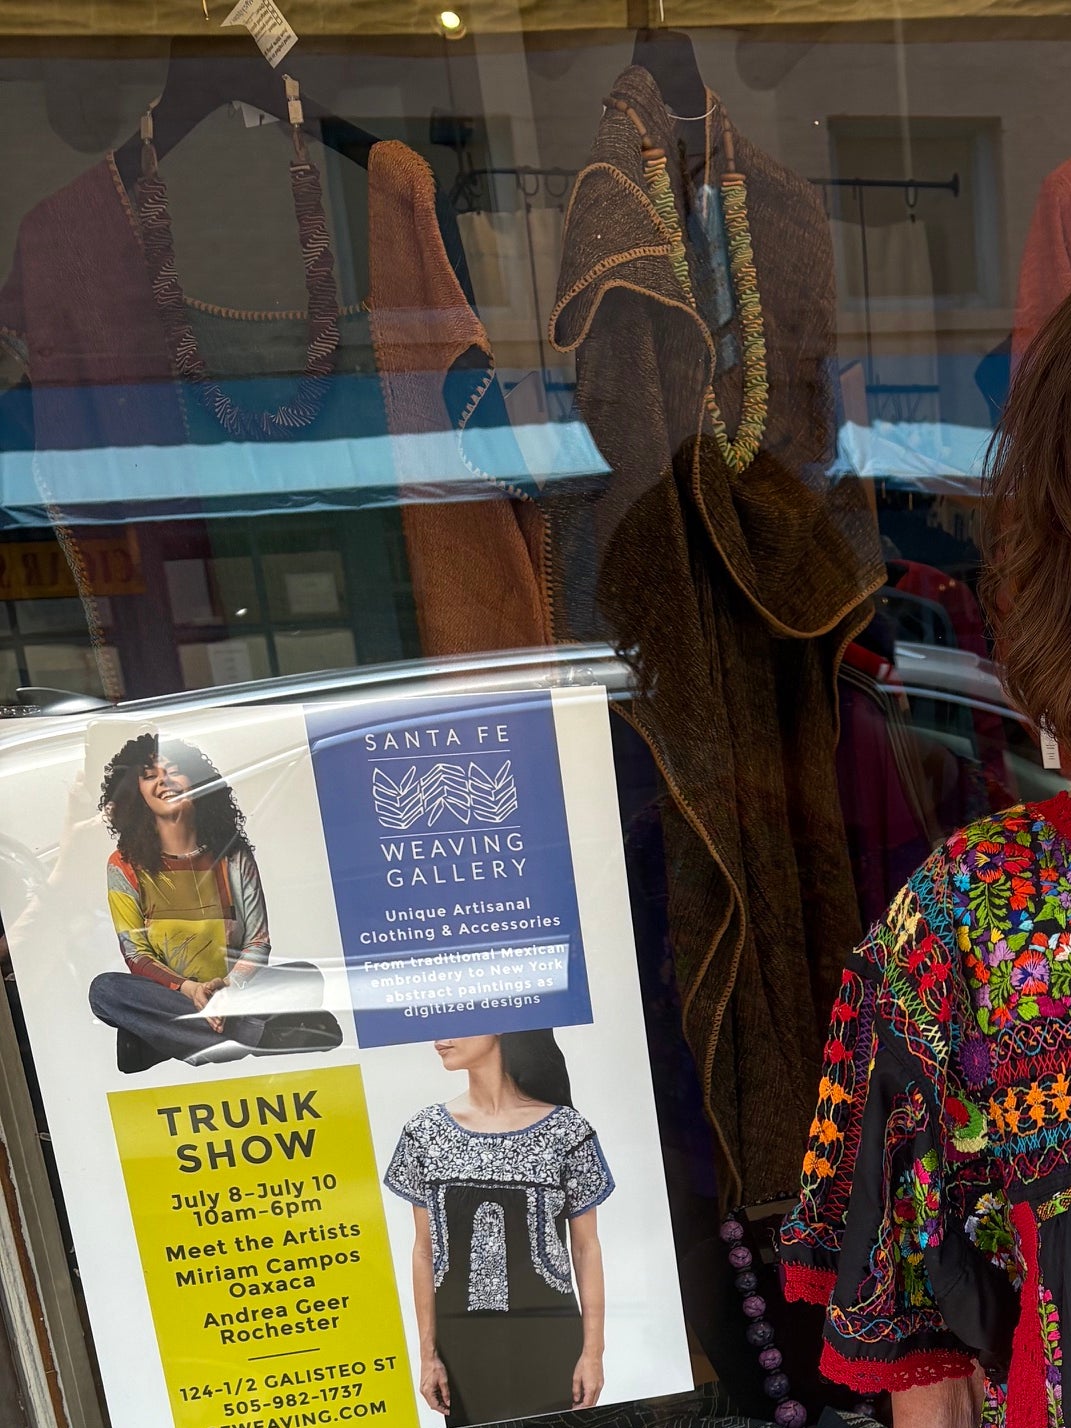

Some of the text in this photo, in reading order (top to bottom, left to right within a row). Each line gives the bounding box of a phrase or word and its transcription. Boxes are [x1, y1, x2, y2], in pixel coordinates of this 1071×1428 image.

[364, 724, 510, 751] SANTA FE
[380, 833, 524, 862] WEAVING
[386, 858, 526, 888] GALLERY
[385, 897, 531, 922] Unique Artisanal
[359, 915, 561, 945] Clothing & Accessories
[363, 943, 565, 972] From traditional Mexican
[370, 958, 564, 988] embroidery to New York
[385, 976, 554, 1003] abstract paintings as
[404, 993, 541, 1018] digitized designs
[157, 1090, 322, 1136] TRUNK
[176, 1129, 316, 1173] SHOW
[171, 1190, 220, 1210] July
[311, 1173, 337, 1192] 10
[165, 1222, 361, 1262] Meet the Artists
[175, 1250, 361, 1287] Miriam Campos
[229, 1275, 316, 1298] Oaxaca
[203, 1296, 350, 1329] Andrea Geer
[220, 1315, 340, 1345] Rochester
[179, 1356, 397, 1402] 124-1/2 GALISTEO ST
[223, 1383, 364, 1417] 505-982-1737
